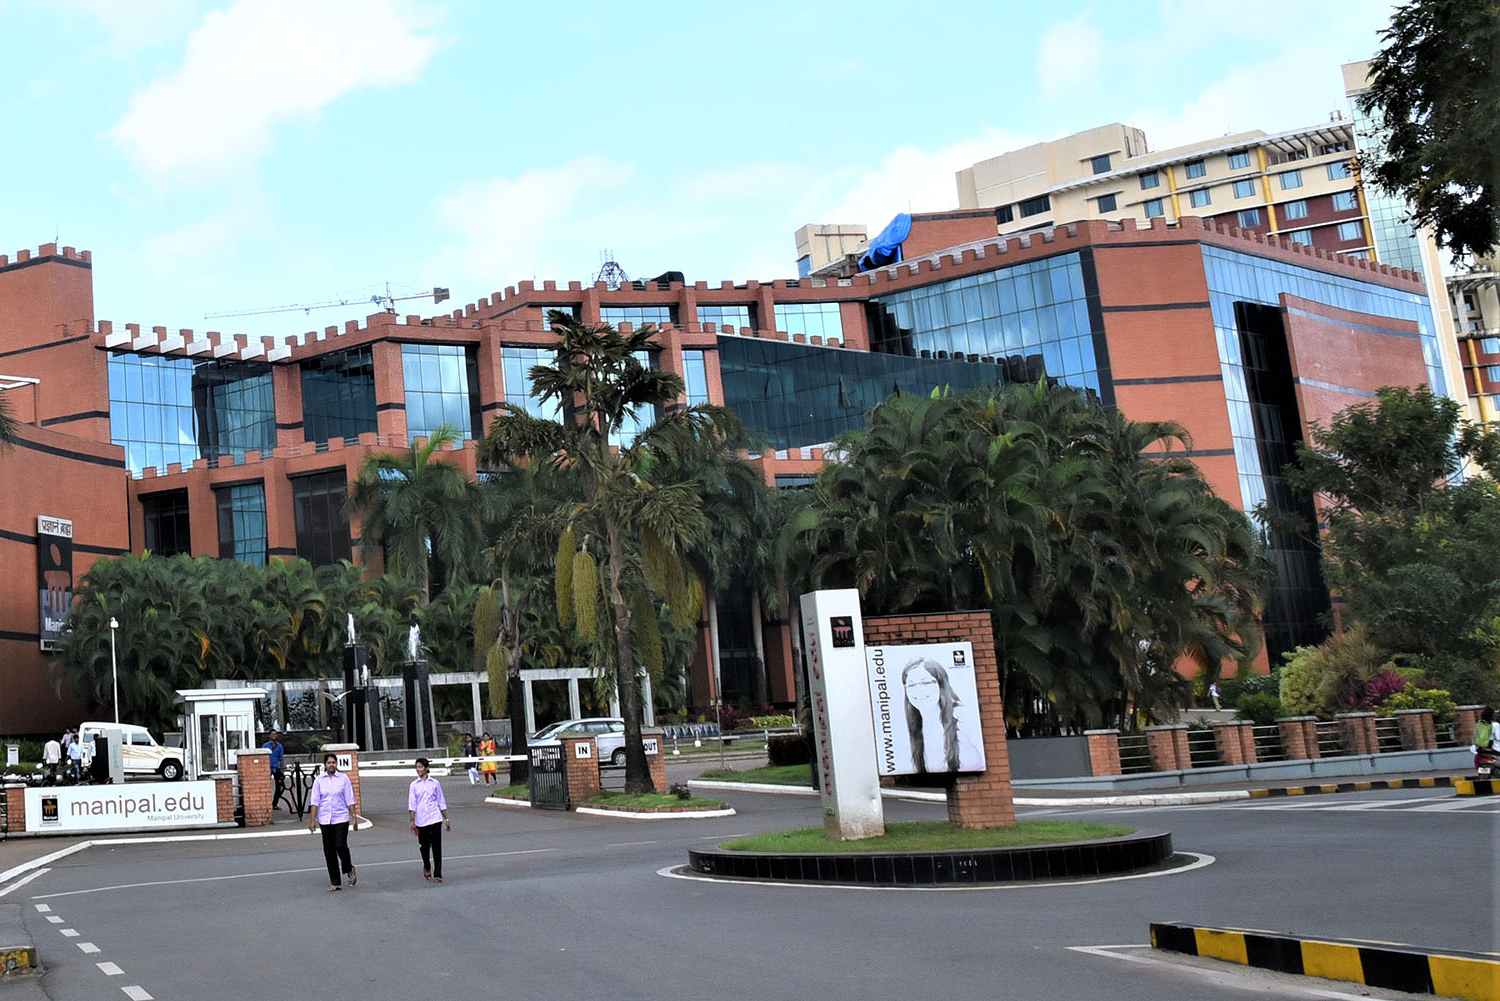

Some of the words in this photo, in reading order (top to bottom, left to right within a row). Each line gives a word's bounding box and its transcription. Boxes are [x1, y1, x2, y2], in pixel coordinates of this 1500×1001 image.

[45, 617, 72, 633] Mani
[872, 649, 896, 773] www.manipal.edu
[578, 746, 588, 755] IN
[644, 743, 657, 751] OUT
[339, 758, 349, 767] IN
[71, 792, 204, 818] manipal.edu
[147, 814, 173, 822] Manipal
[173, 812, 205, 820] University
